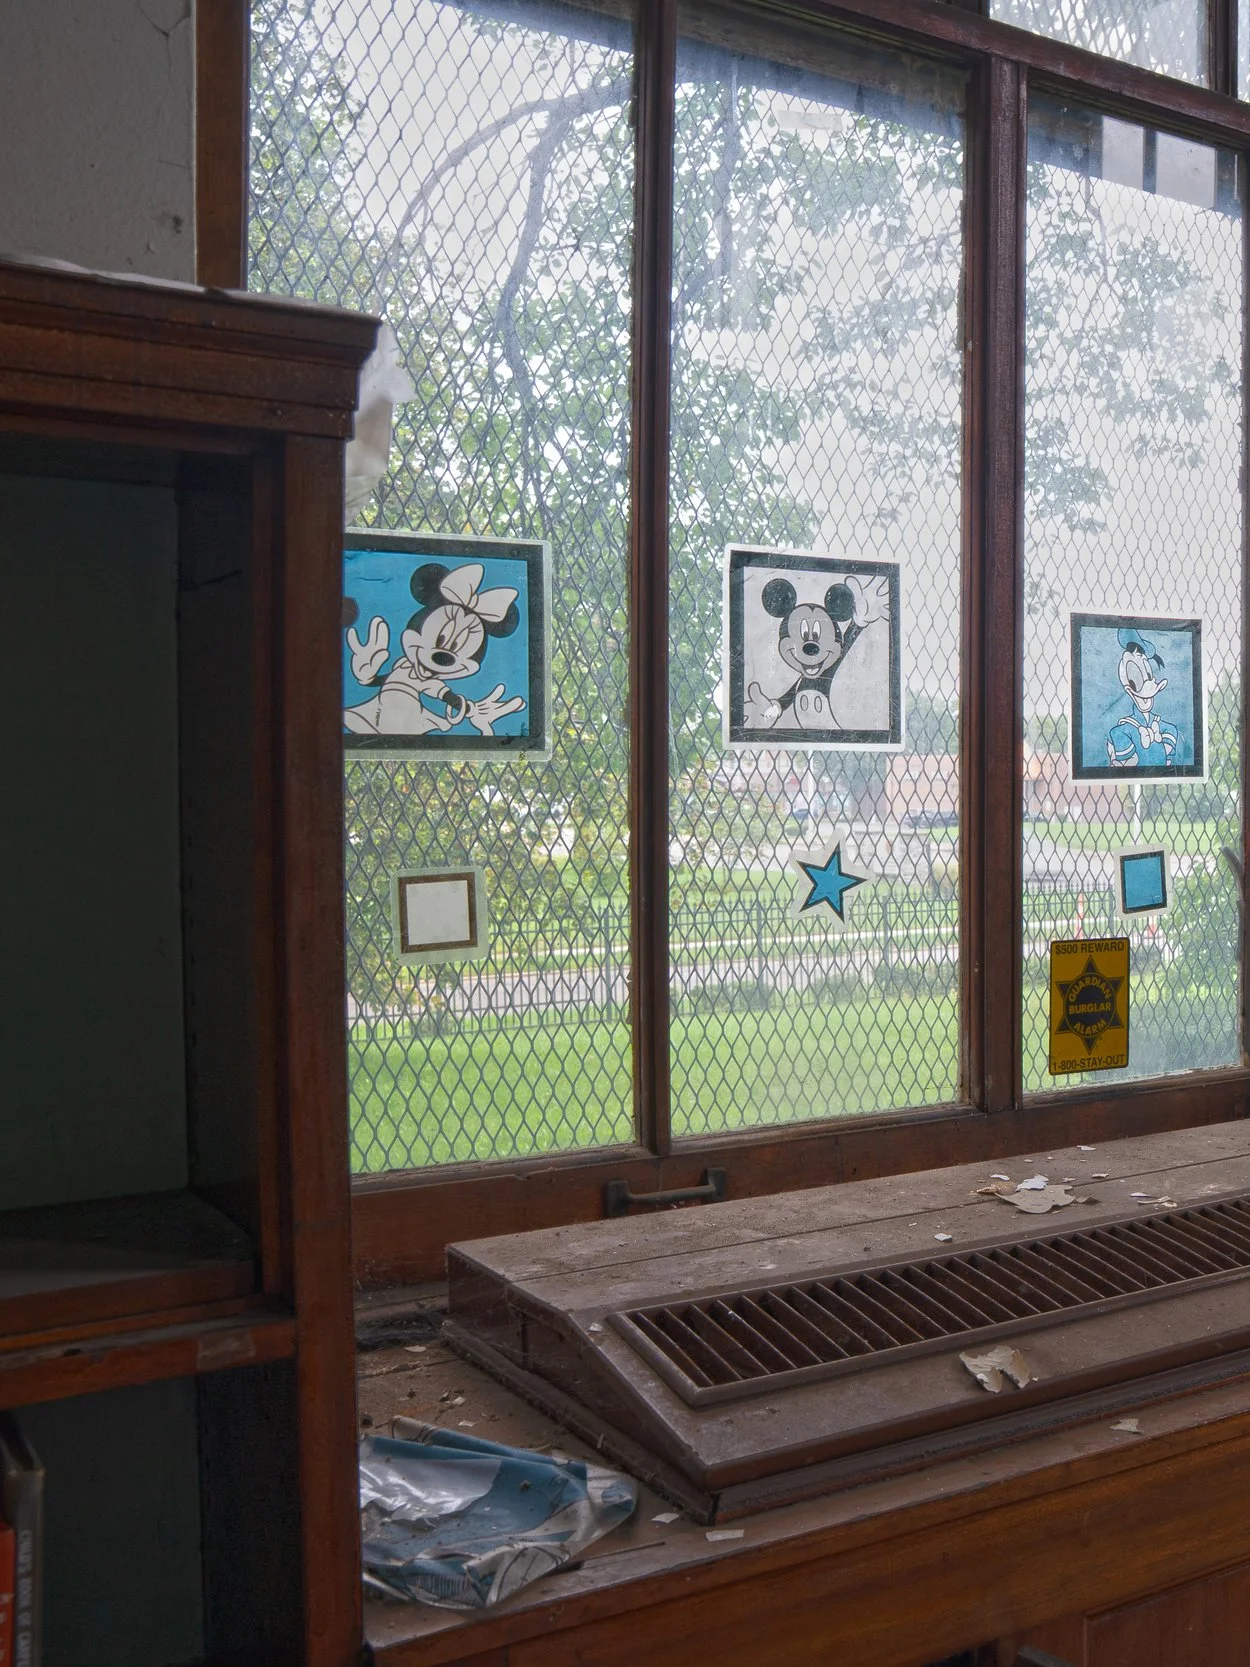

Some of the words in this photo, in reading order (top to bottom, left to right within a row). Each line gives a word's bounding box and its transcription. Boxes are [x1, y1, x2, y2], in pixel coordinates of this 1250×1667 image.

[1055, 944, 1078, 955] $500
[1080, 941, 1125, 954] REWARD
[1068, 976, 1112, 1002] GUARDIAN
[1069, 1002, 1111, 1015] BURGLAR
[1074, 1018, 1107, 1035] ALARM
[1052, 1054, 1126, 1072] 1-800-STAY-OUT
[17, 1576, 32, 1607] BOOK
[17, 1611, 32, 1627] OF
